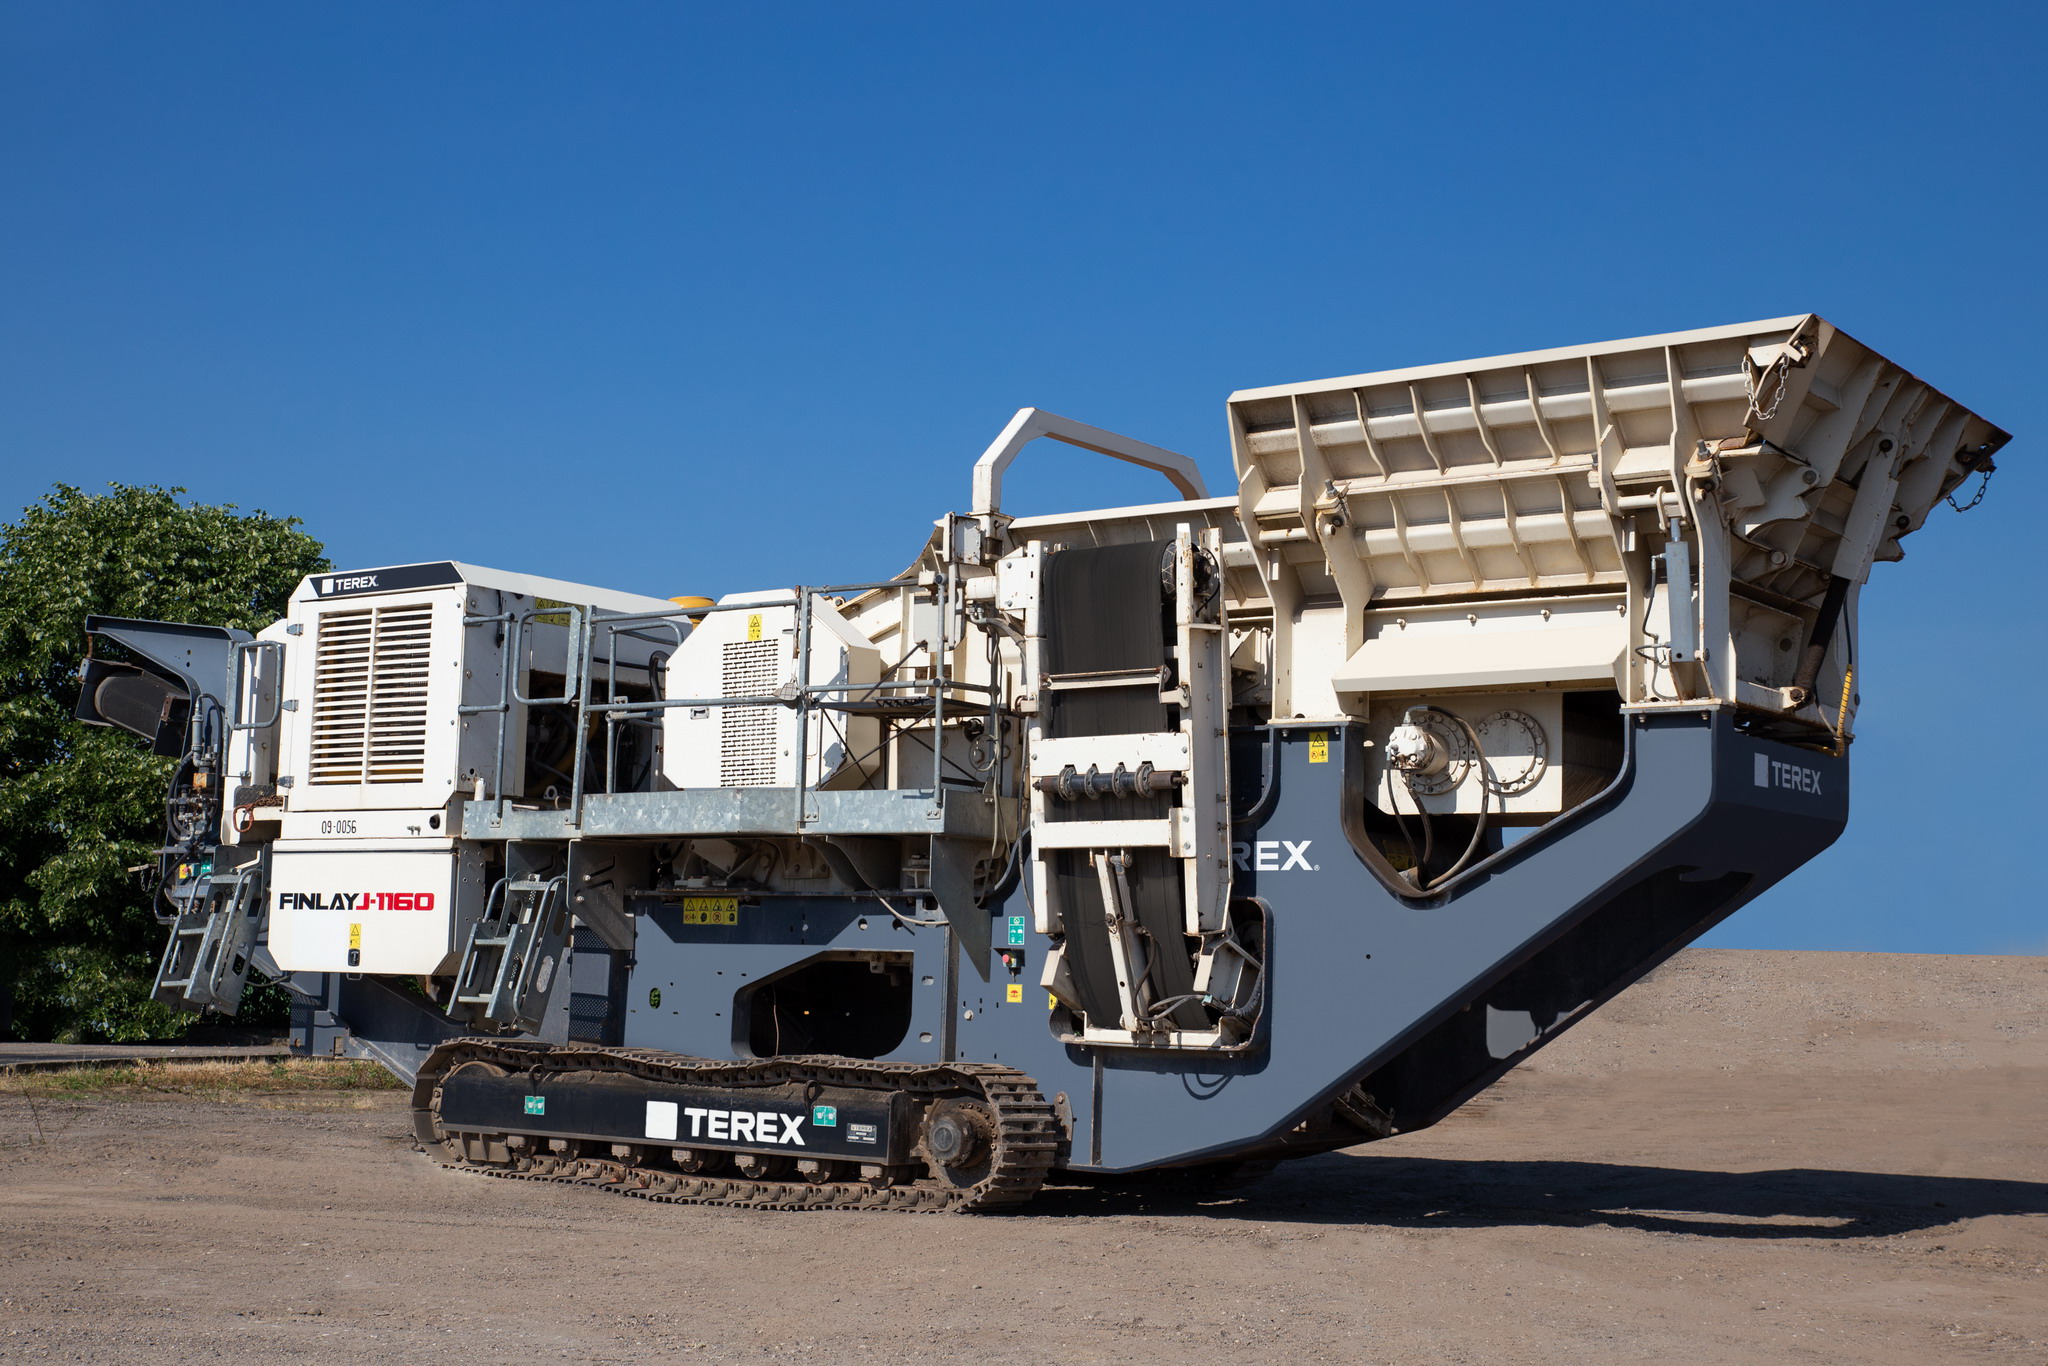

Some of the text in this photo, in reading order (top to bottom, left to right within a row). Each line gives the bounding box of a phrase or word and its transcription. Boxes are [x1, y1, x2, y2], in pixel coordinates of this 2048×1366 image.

[335, 575, 379, 591] TEREX
[1771, 760, 1822, 796] TEREX
[321, 819, 357, 834] 09-0056
[684, 1097, 806, 1146] TEREX
